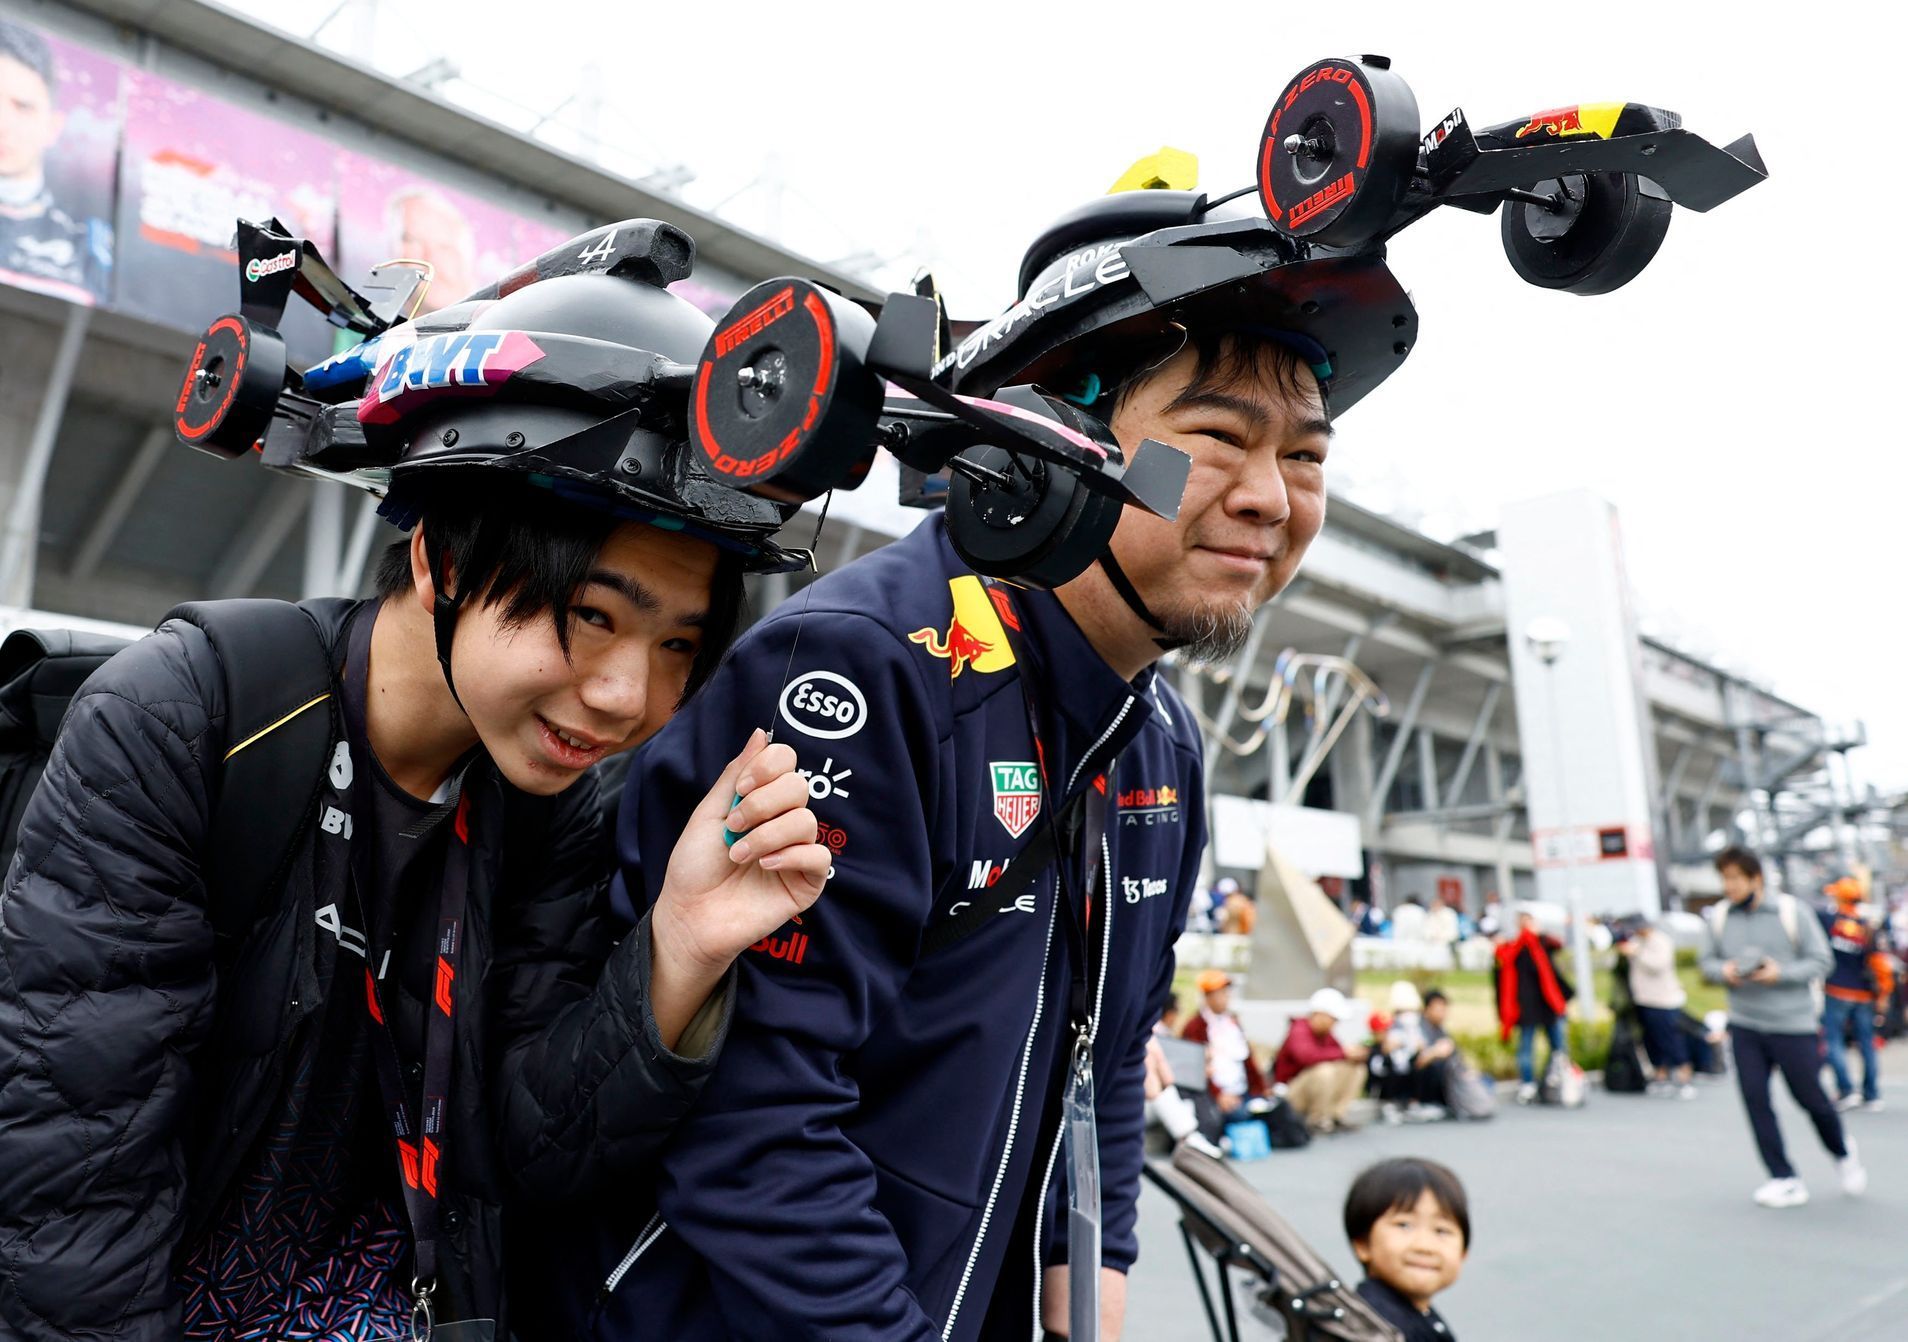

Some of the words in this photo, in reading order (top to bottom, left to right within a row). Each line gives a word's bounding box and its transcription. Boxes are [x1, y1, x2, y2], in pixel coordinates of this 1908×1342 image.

[1284, 66, 1353, 111] ZERO
[1424, 108, 1463, 155] Mobil
[1289, 171, 1355, 229] PIRELLI
[260, 250, 296, 275] Castrol
[715, 286, 795, 359] PIRELLI
[380, 333, 502, 400] BWT
[997, 767, 1038, 790] TAG
[997, 797, 1039, 833] HEUER
[1117, 811, 1179, 827] ACING
